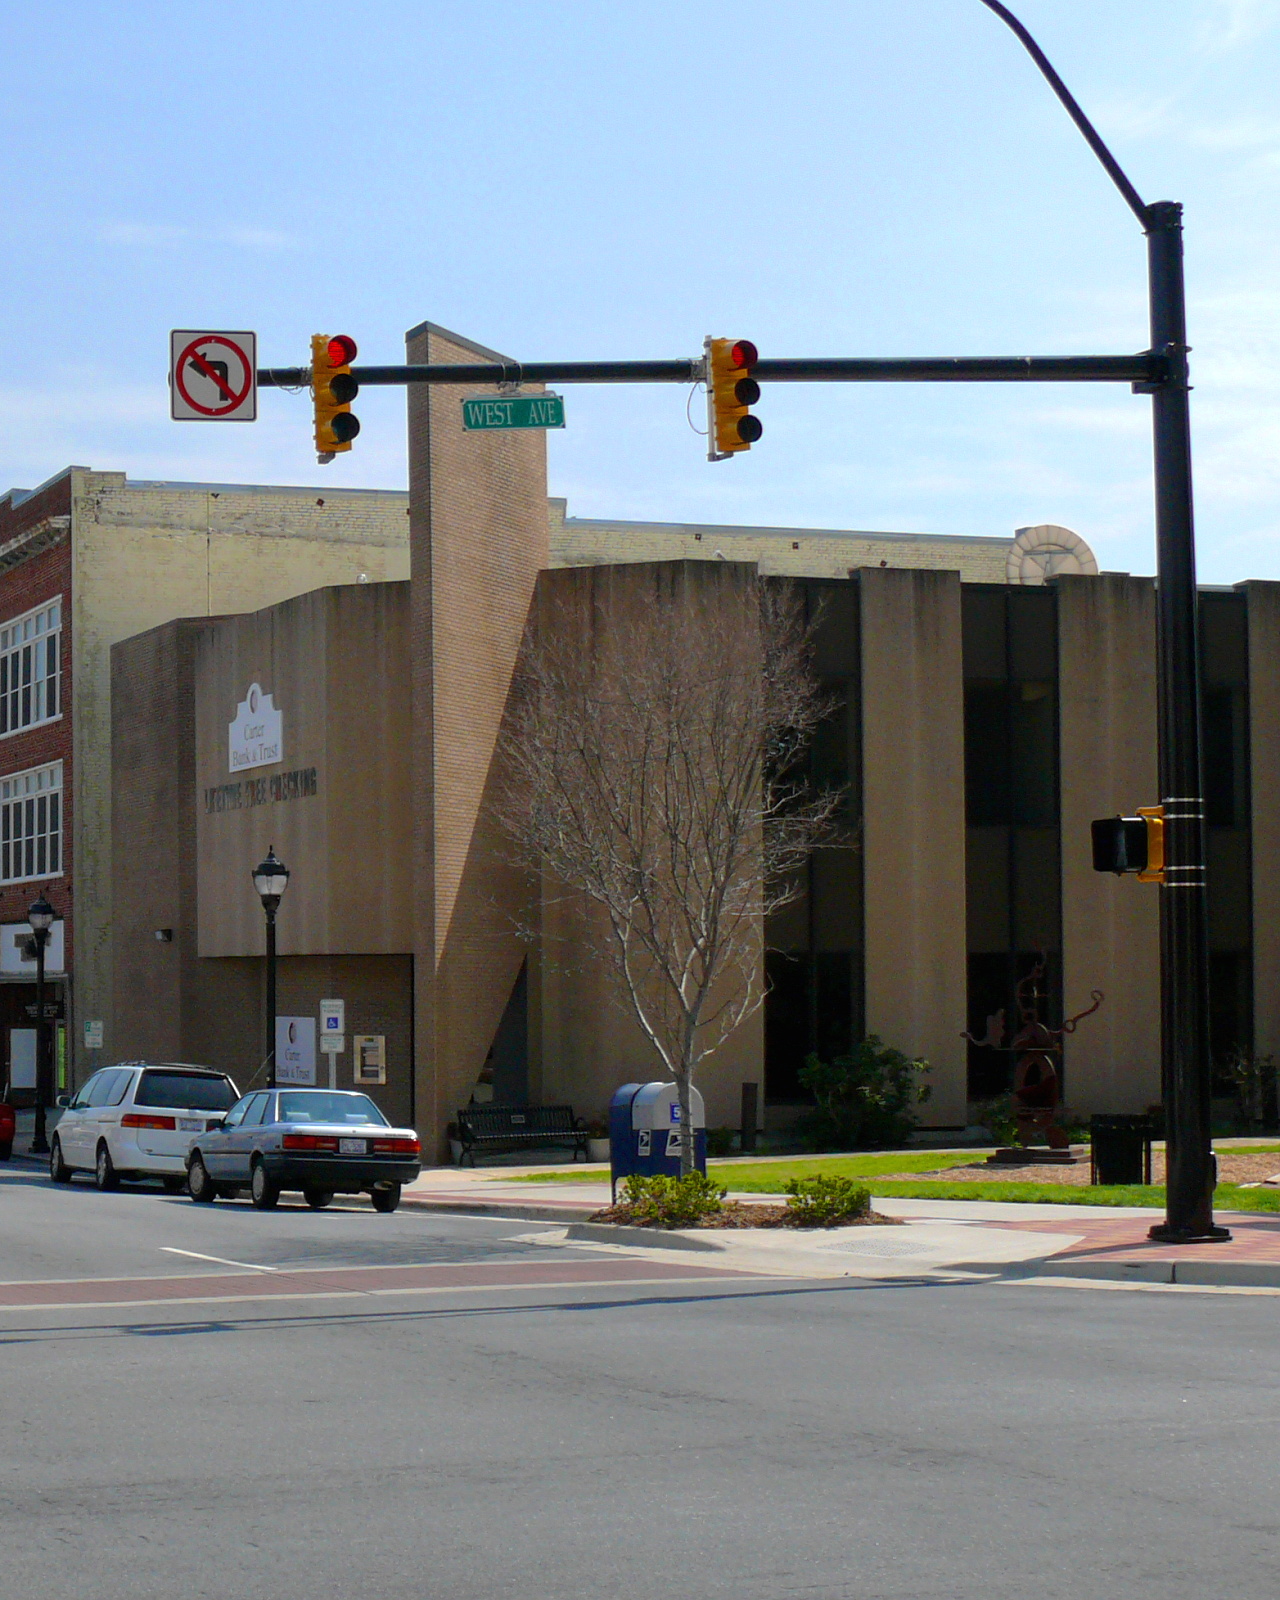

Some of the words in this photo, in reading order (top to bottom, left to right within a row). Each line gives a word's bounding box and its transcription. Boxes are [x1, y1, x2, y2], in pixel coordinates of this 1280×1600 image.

[468, 403, 513, 425] WEST
[528, 401, 556, 424] AVE
[258, 743, 278, 761] Trust
